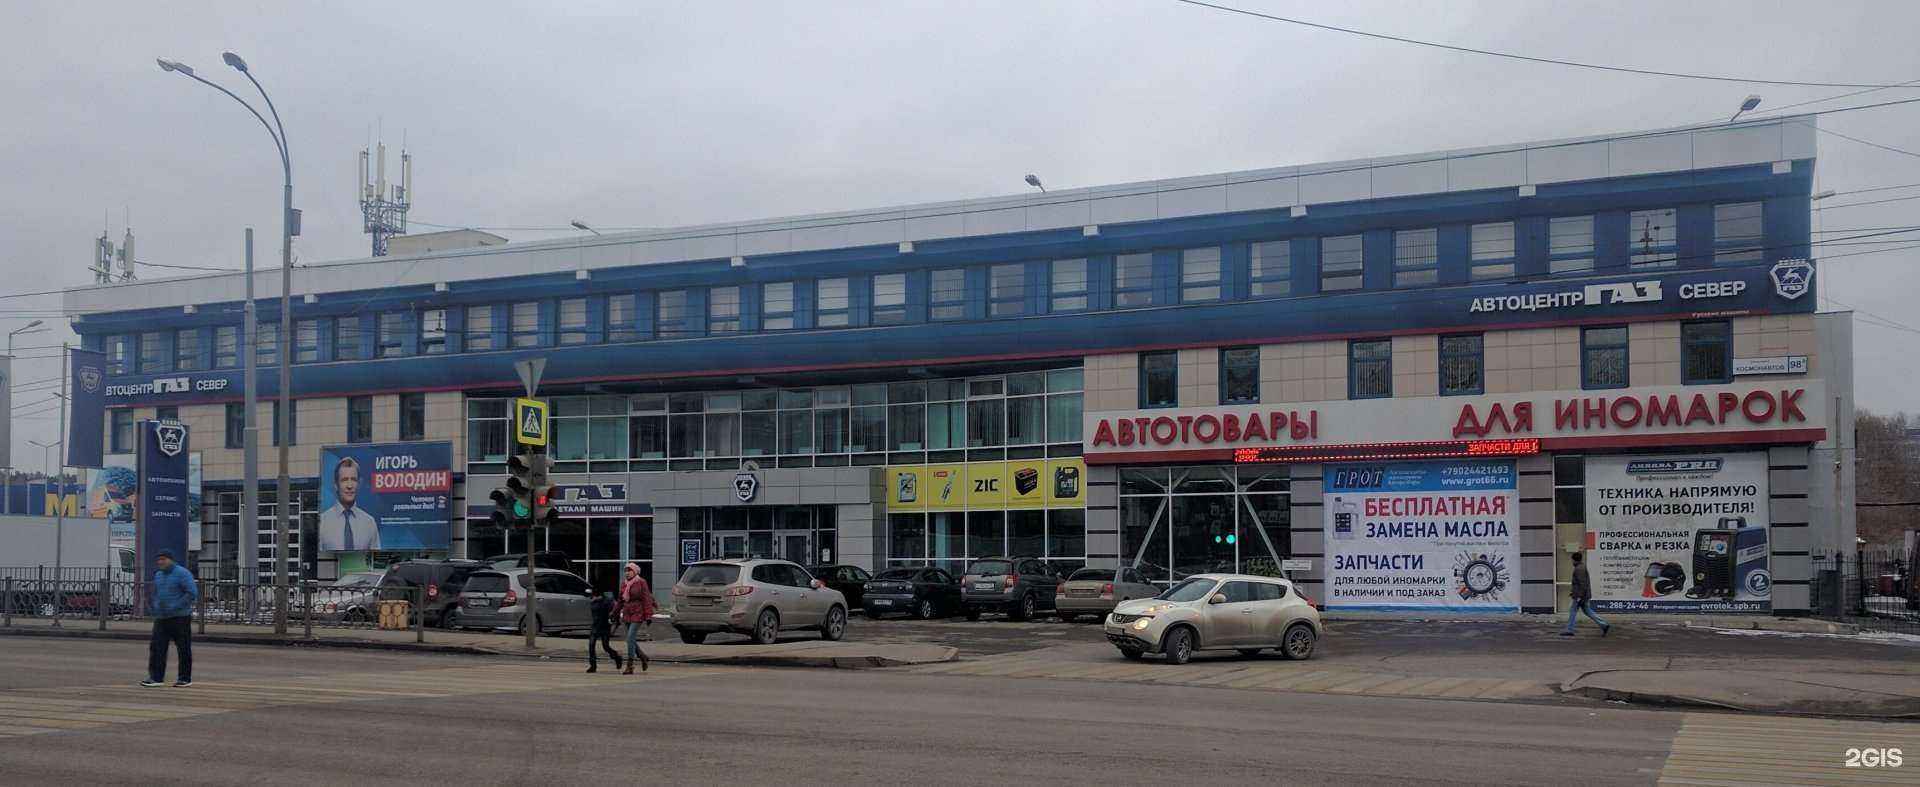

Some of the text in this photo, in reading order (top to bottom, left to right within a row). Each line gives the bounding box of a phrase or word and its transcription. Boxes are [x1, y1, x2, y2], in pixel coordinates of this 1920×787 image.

[1470, 280, 1747, 313] АВТОЦЕНТР ГАЗ СЕВЕР
[105, 377, 228, 397] ВТОЦЕНТР ГАЗ СЕВЕР
[1452, 389, 1806, 439] ДЛЯ ИНОМАРОК
[1092, 410, 1318, 447] АВТОТОВАРЫ
[1468, 442, 1511, 452] ЗАПЧАСТИ
[375, 455, 418, 469] ИГОРЬ
[375, 472, 447, 490] ВОЛОДИН
[1335, 468, 1384, 486] ГРОТ
[1441, 465, 1509, 475] +79024421493
[1441, 477, 1509, 487] www.grot66.ru
[974, 479, 999, 492] ZIC
[1599, 484, 1758, 499] ТЕХНИКА НАПРЯМУЮ
[554, 504, 624, 513] ЕТАЛИ МАШИН
[1365, 496, 1507, 516] БЕСПЛАТНАЯ
[1599, 502, 1755, 516] ОТ ПРОИЗВОДИТЕЛЯ!
[1366, 521, 1509, 537] ЗАМЕНА МАСЛА
[1600, 531, 1690, 539] ПРОФЕССИОНАЛЬНАЯ
[1600, 542, 1643, 550] СВАРКА
[1655, 541, 1690, 550] РЕЗКА
[1334, 554, 1423, 570] ЗАПЧАСТИ
[1335, 574, 1446, 586] ДЛЯ ЛЮБОЙ ИНОМАРКИ
[1334, 588, 1446, 598] В НАЛИЧИИ И ПОД ЗАКАЗ
[1609, 601, 1649, 610] 288-24-46
[1701, 602, 1761, 611] evrotek.spb.ru
